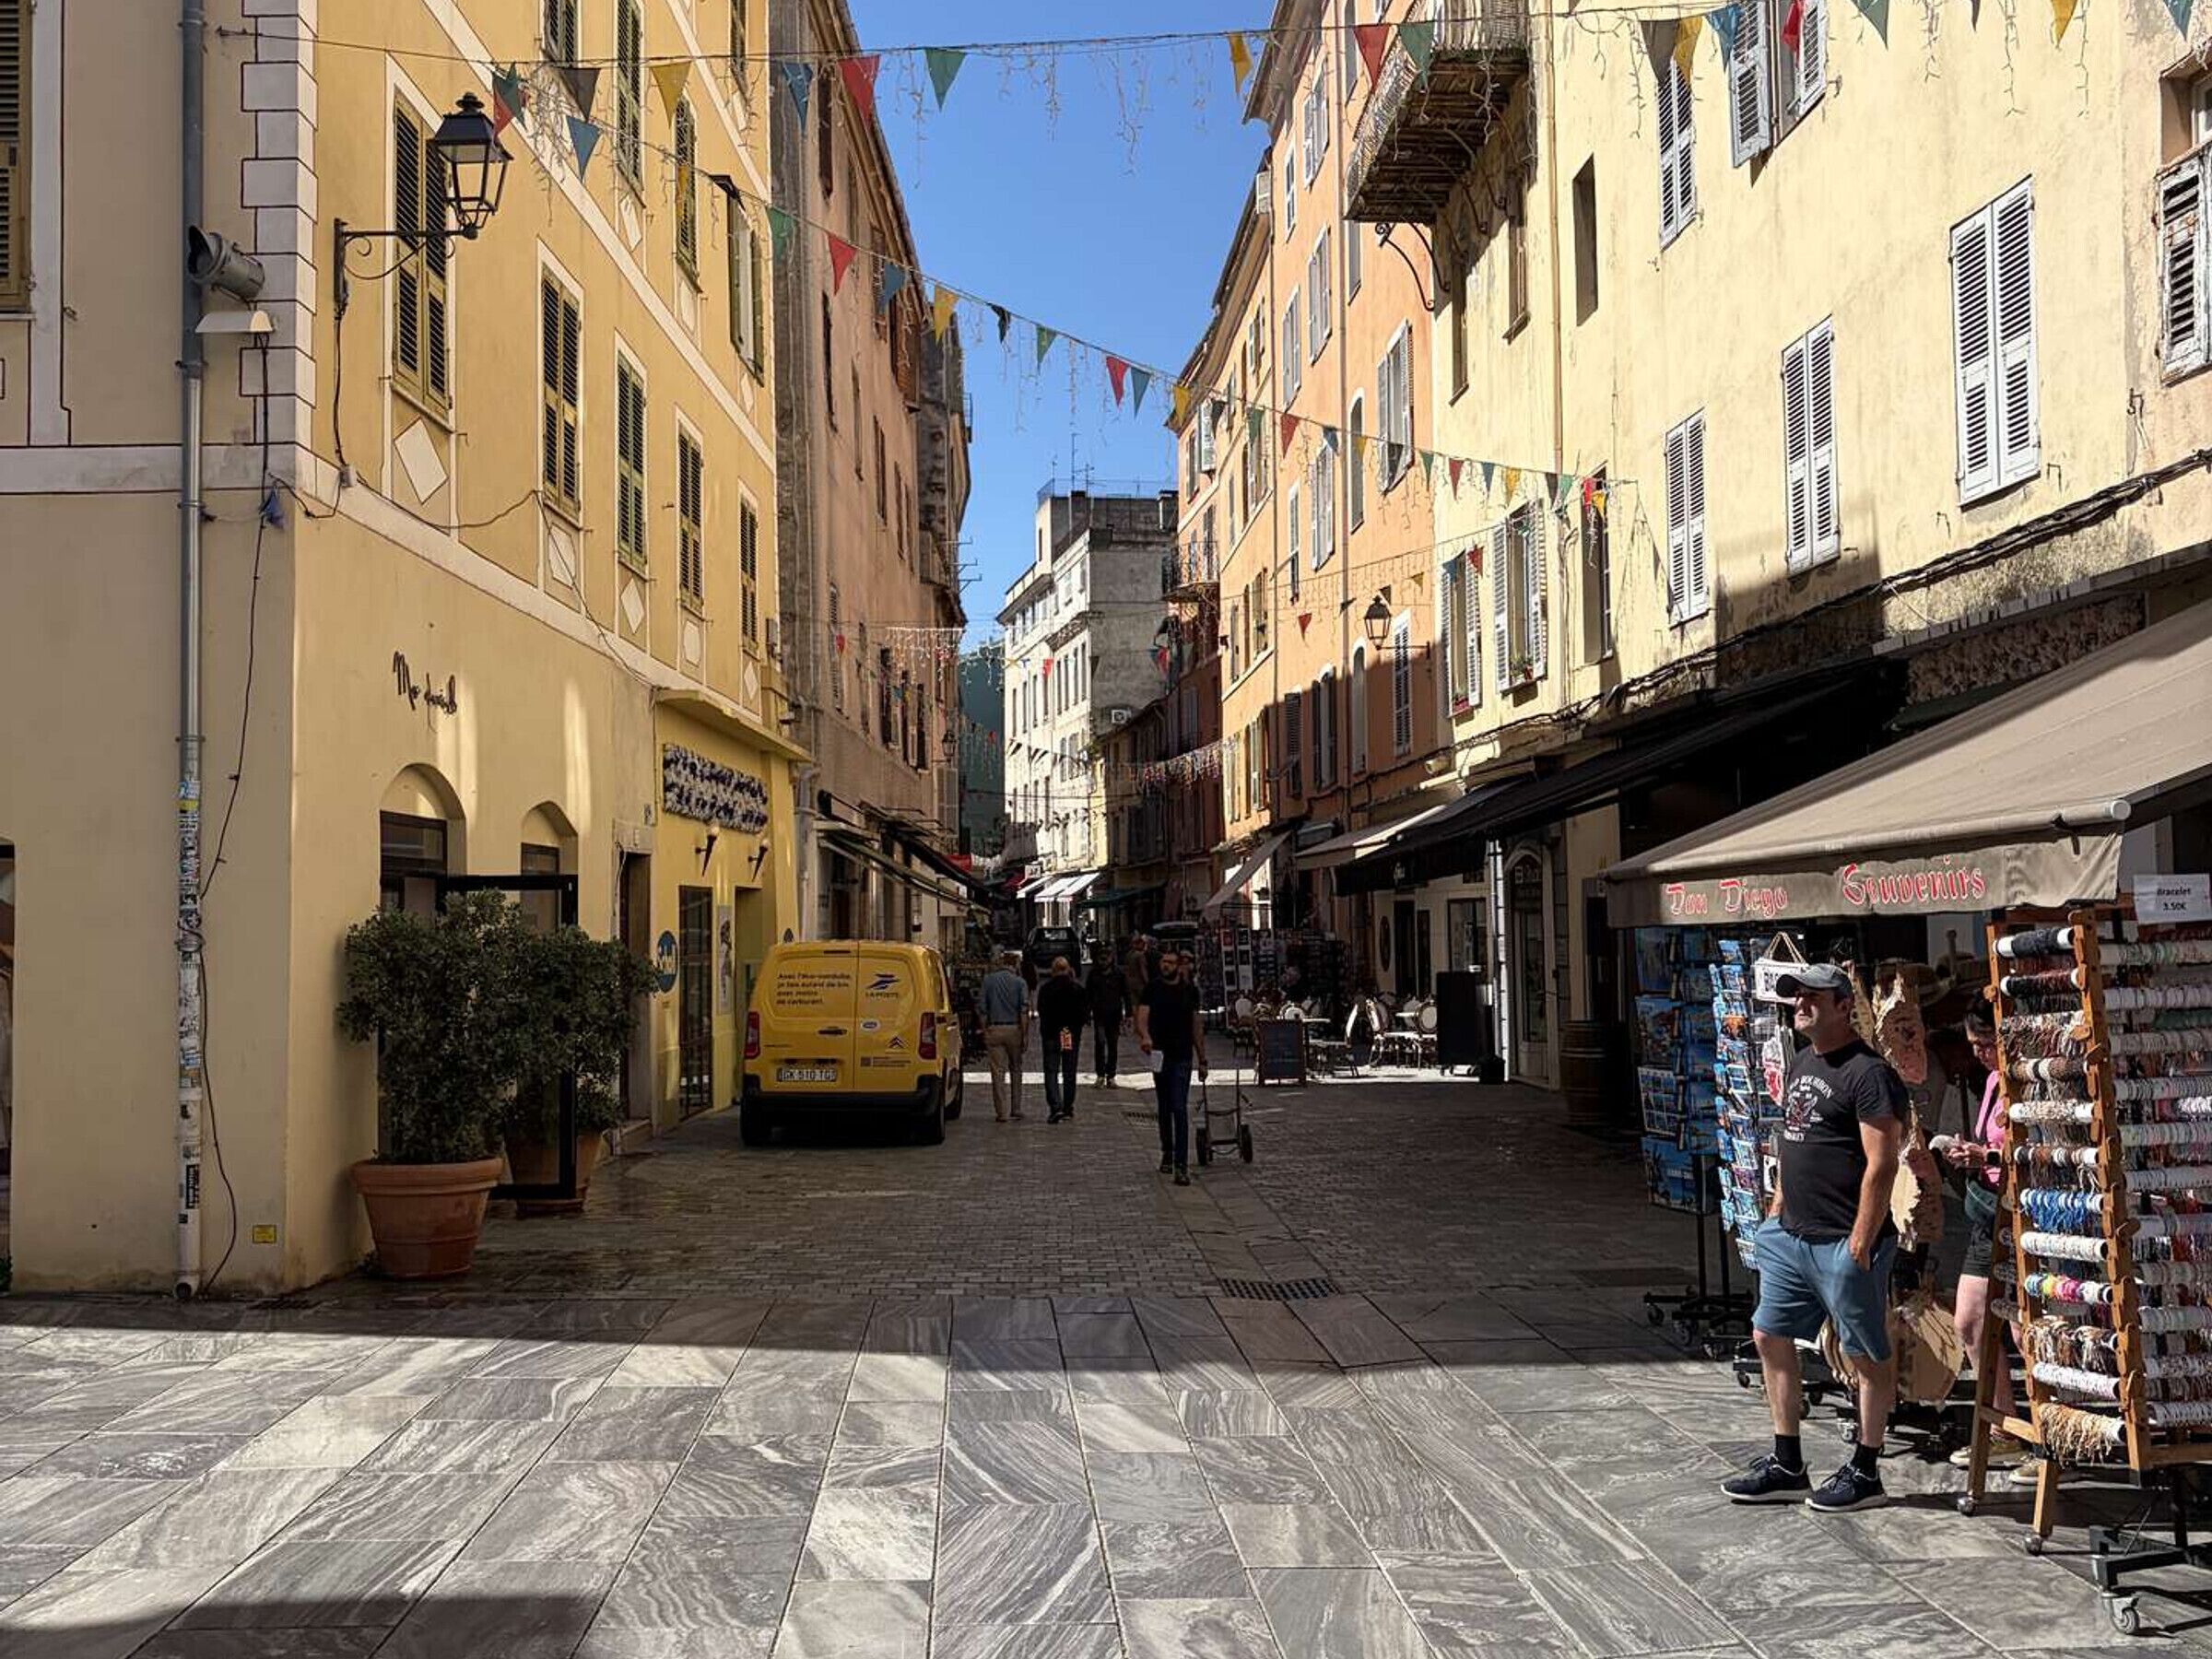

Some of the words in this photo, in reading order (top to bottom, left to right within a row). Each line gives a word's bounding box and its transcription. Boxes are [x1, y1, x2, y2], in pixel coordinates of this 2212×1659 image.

[1666, 882, 1709, 915] Don
[1719, 878, 1788, 918] Diego
[1842, 854, 1986, 905] Souvenirs
